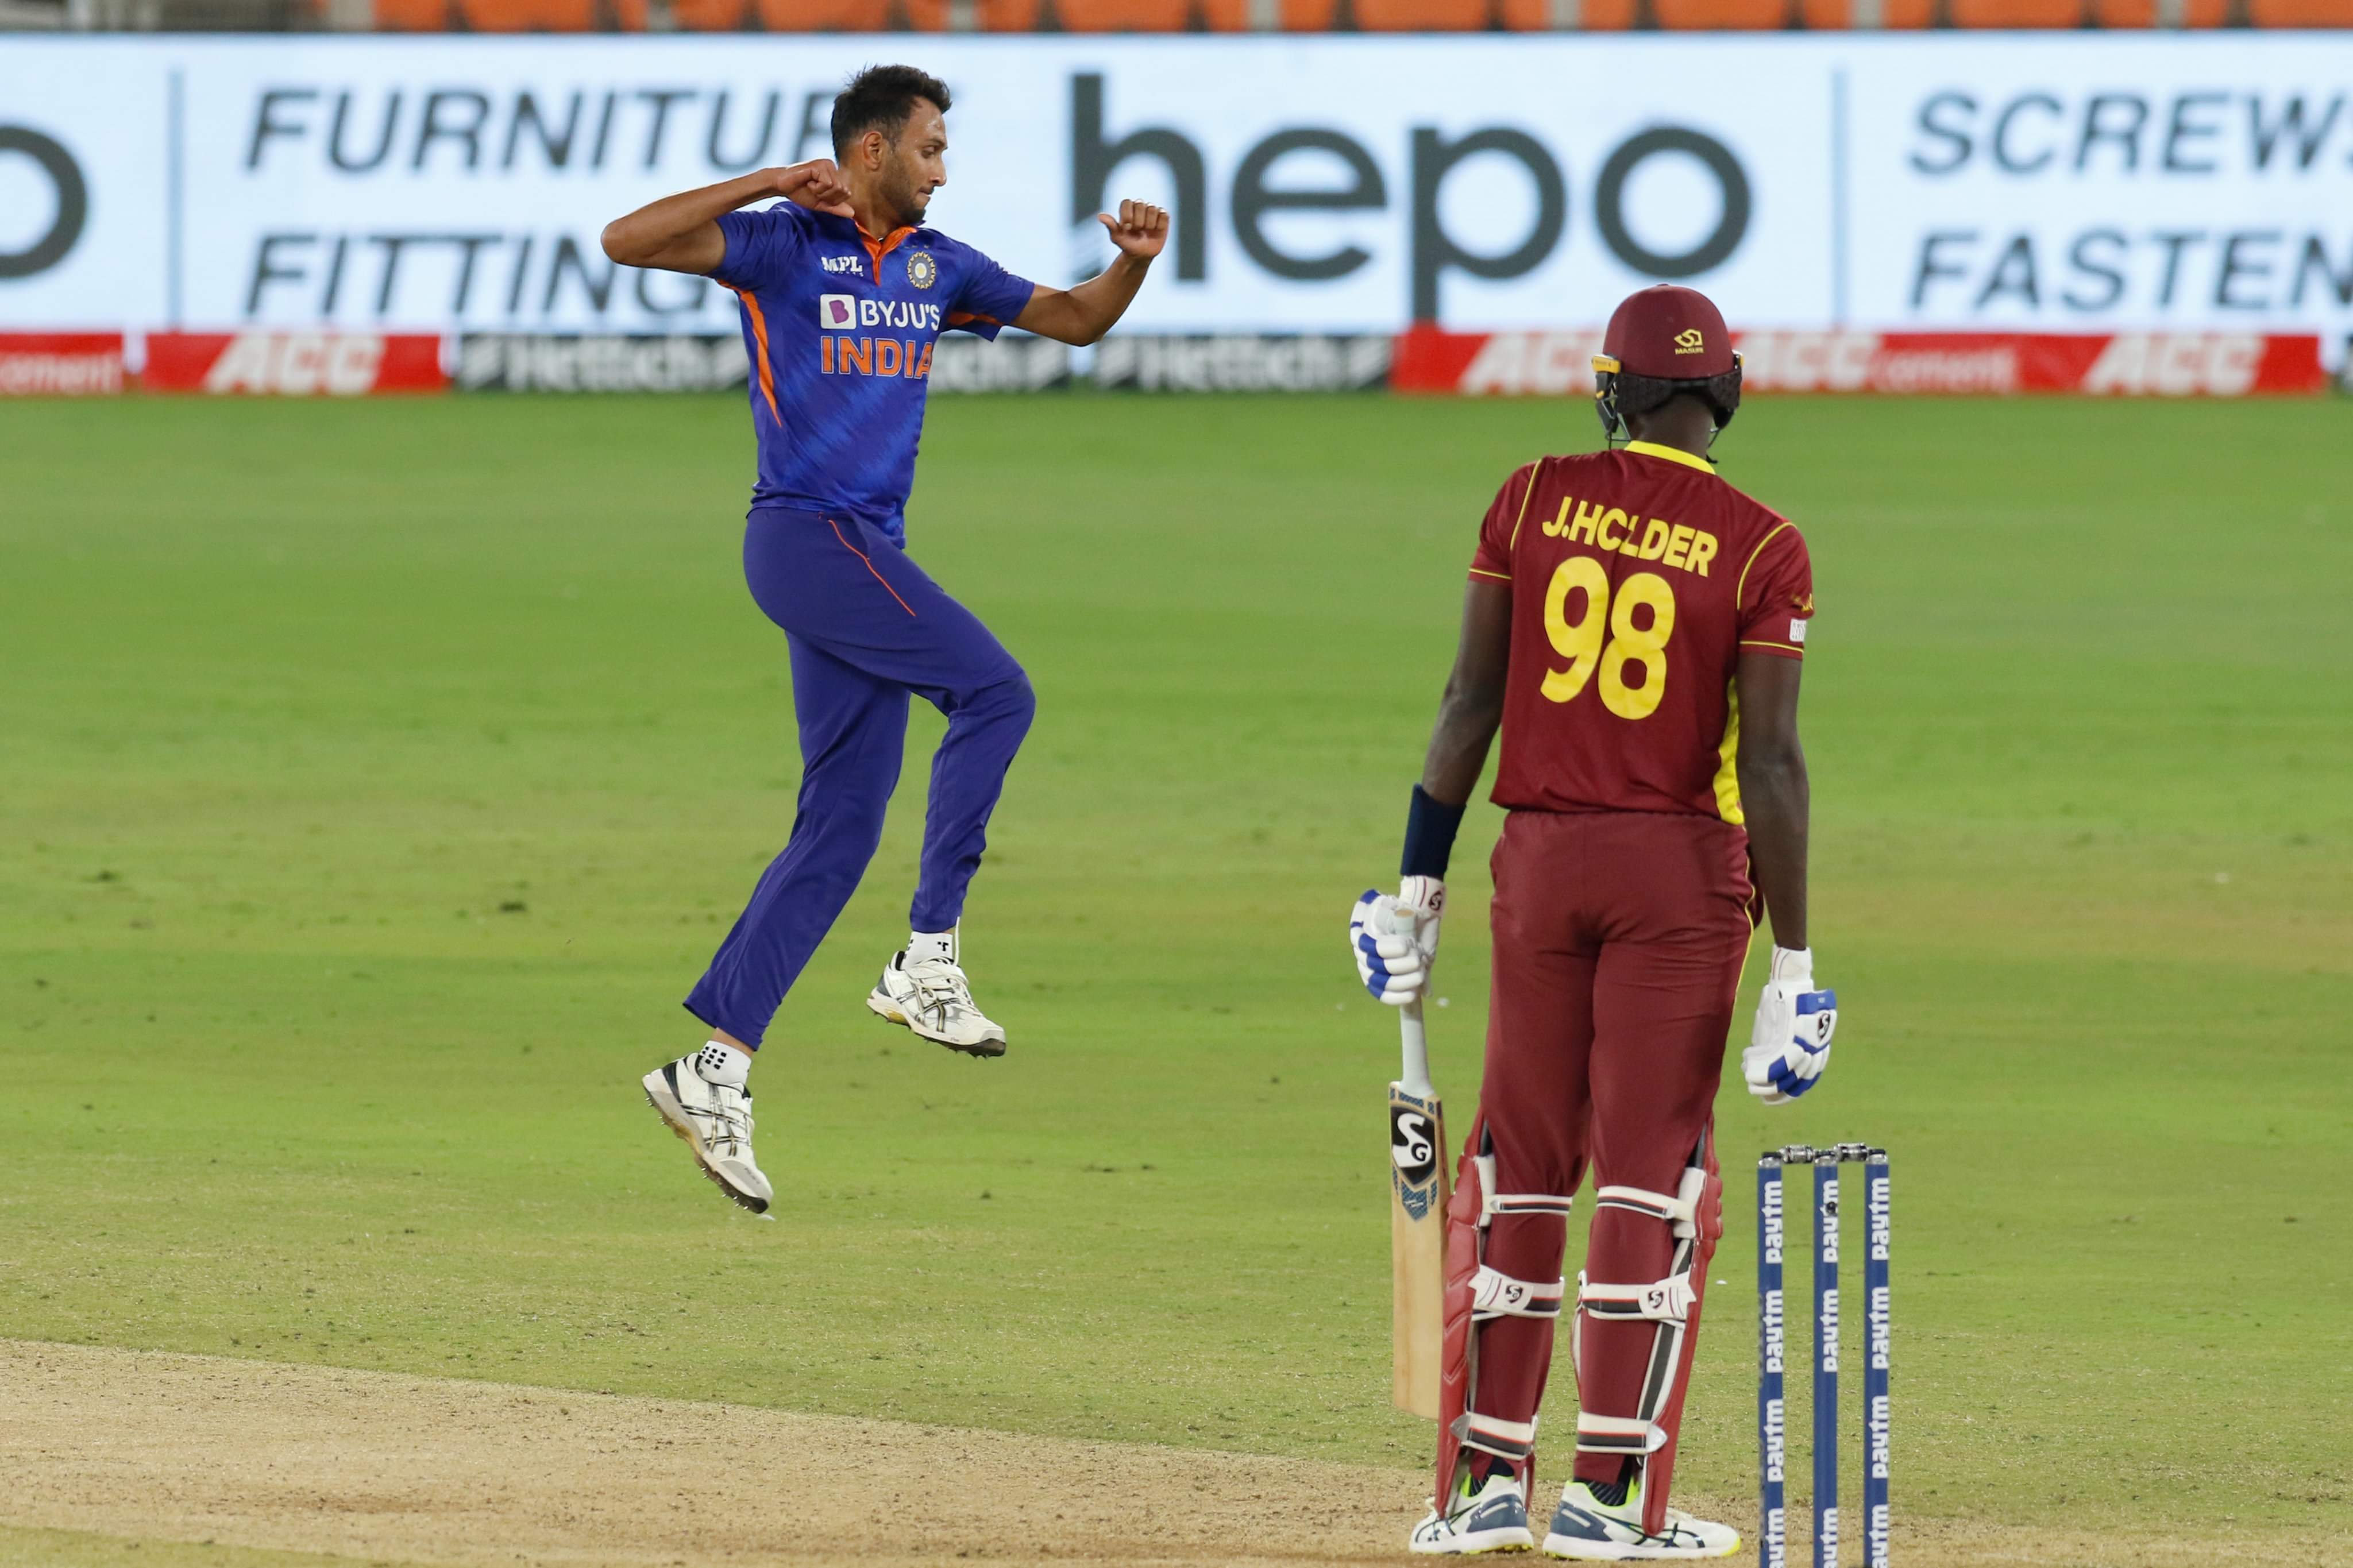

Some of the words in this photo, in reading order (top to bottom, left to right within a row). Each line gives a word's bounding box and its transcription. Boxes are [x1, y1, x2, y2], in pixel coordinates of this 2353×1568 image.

[246, 88, 836, 176] FURNITU
[1907, 91, 2353, 176] SCREW
[1072, 71, 1751, 331] hepo
[246, 233, 739, 316] FITTING
[821, 256, 863, 272] MPL
[861, 300, 940, 331] BYJU'S
[821, 335, 934, 380] INDIA
[1540, 556, 1676, 720] 98
[1761, 1180, 1783, 1264] paytm
[1868, 1177, 1889, 1260] paytm
[1763, 1289, 1783, 1373] paytm
[1820, 1289, 1839, 1372] paytm
[1868, 1286, 1889, 1370] paytm
[1764, 1399, 1784, 1482] paytm
[1868, 1395, 1889, 1478] paytm
[1766, 1508, 1784, 1568] aytm
[1820, 1508, 1838, 1568] aytm
[1869, 1504, 1889, 1568] aytm
